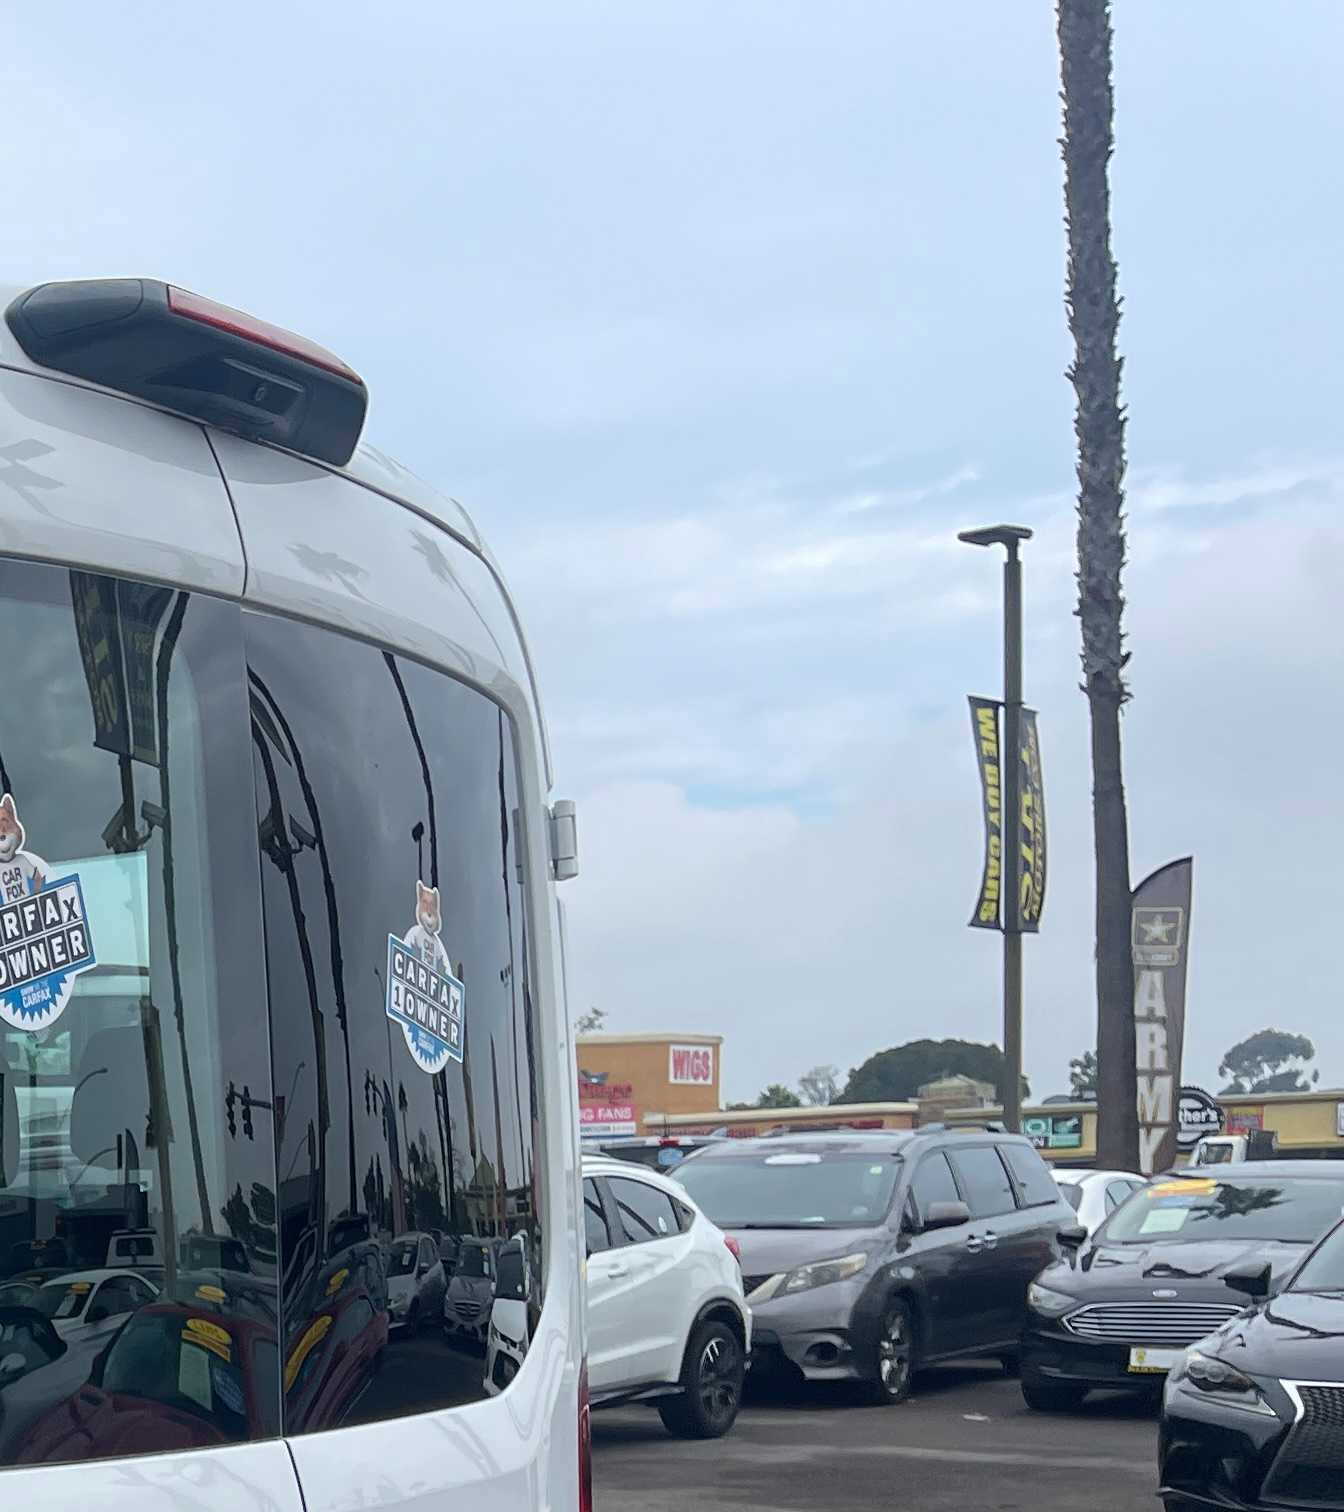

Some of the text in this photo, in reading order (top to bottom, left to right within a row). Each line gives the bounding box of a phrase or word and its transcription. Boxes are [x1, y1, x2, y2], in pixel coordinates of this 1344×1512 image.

[976, 707, 1002, 922] WE BUY CARS
[2, 867, 21, 885] CAR
[6, 882, 26, 901] FOX
[393, 951, 461, 1018] CARFAX
[671, 1048, 711, 1082] WIGS
[1134, 969, 1173, 1174] ARMY
[598, 1107, 632, 1121] FANS
